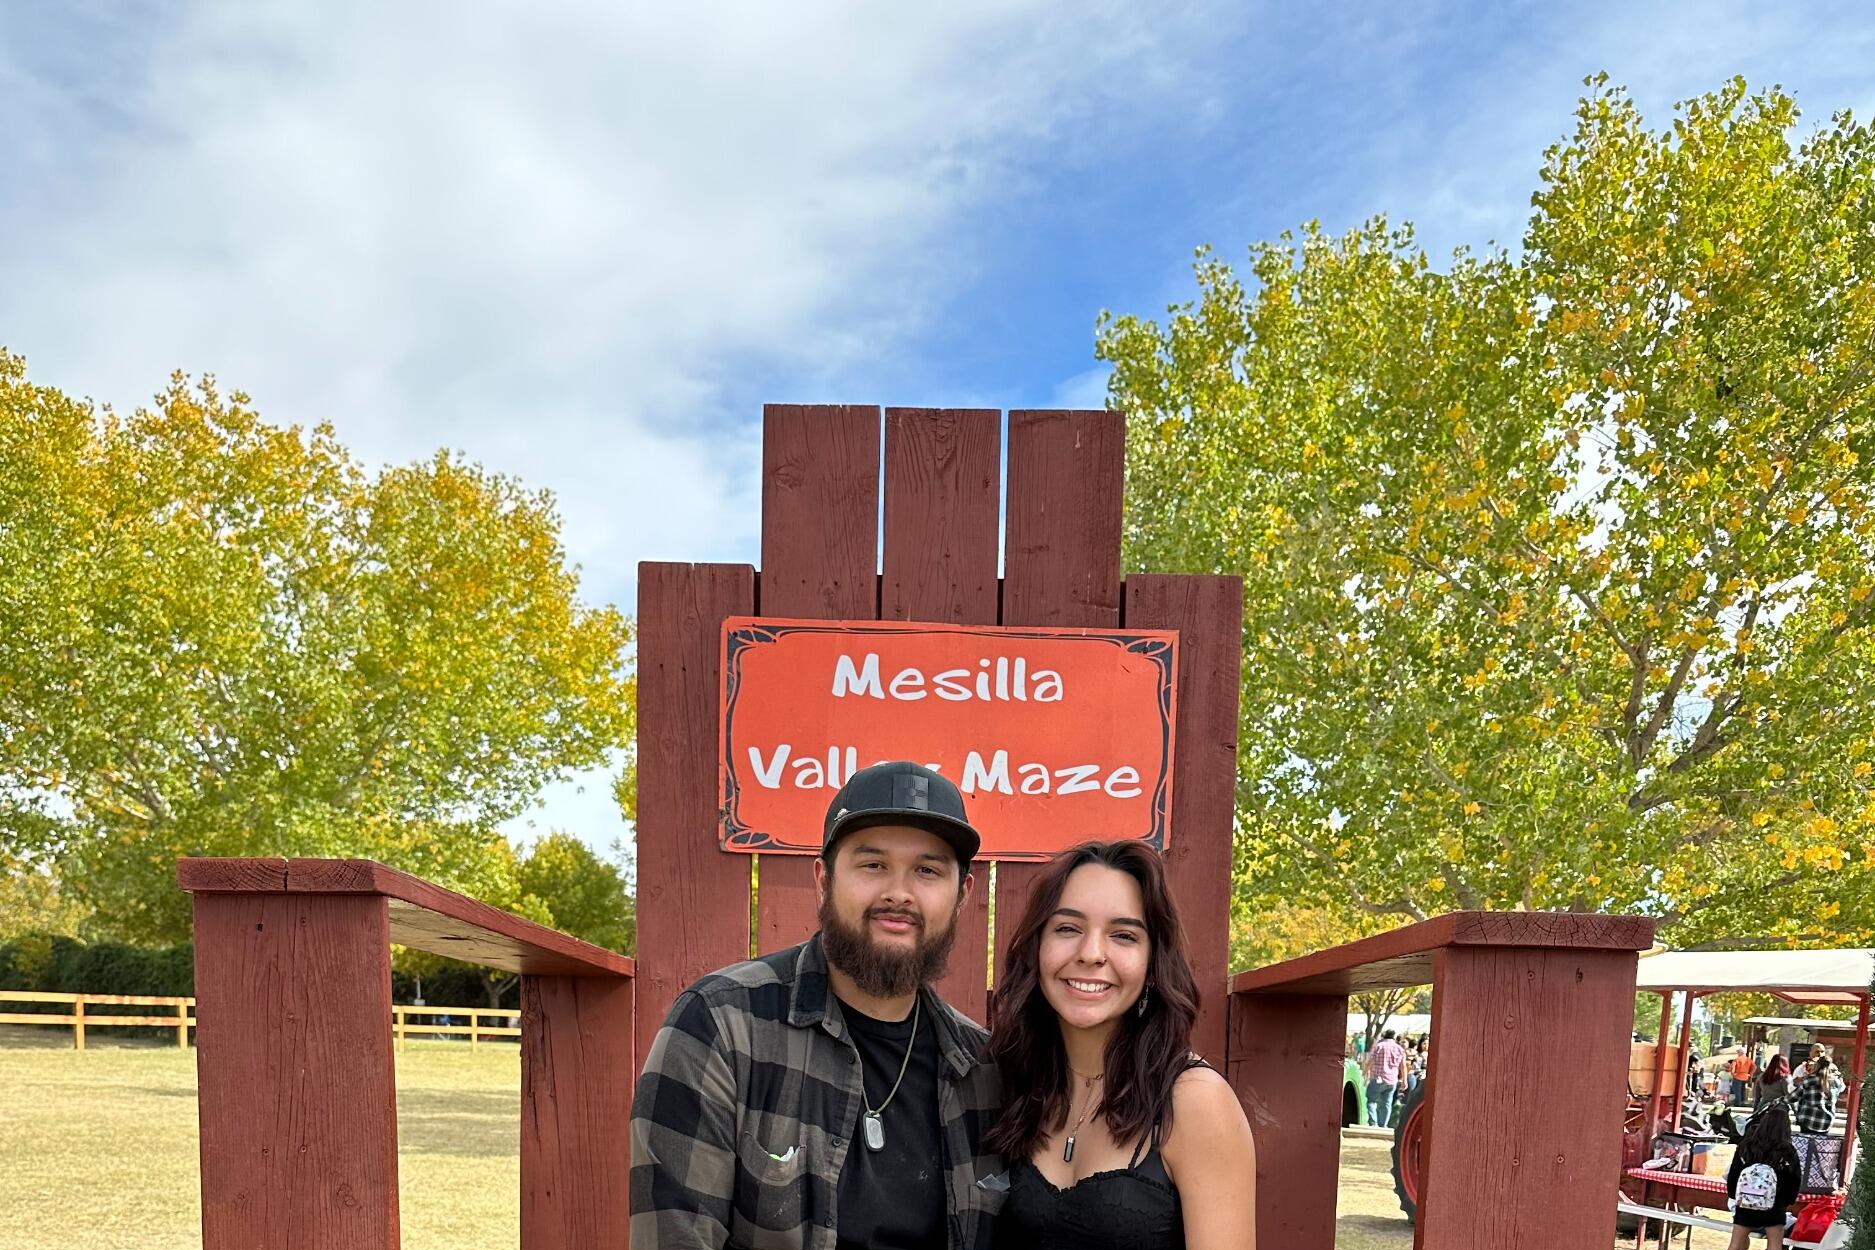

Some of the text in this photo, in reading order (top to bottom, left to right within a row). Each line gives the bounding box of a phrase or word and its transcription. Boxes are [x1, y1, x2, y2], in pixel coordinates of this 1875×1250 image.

[832, 652, 1064, 702] Mesilla
[748, 743, 1143, 798] Vall Maze
